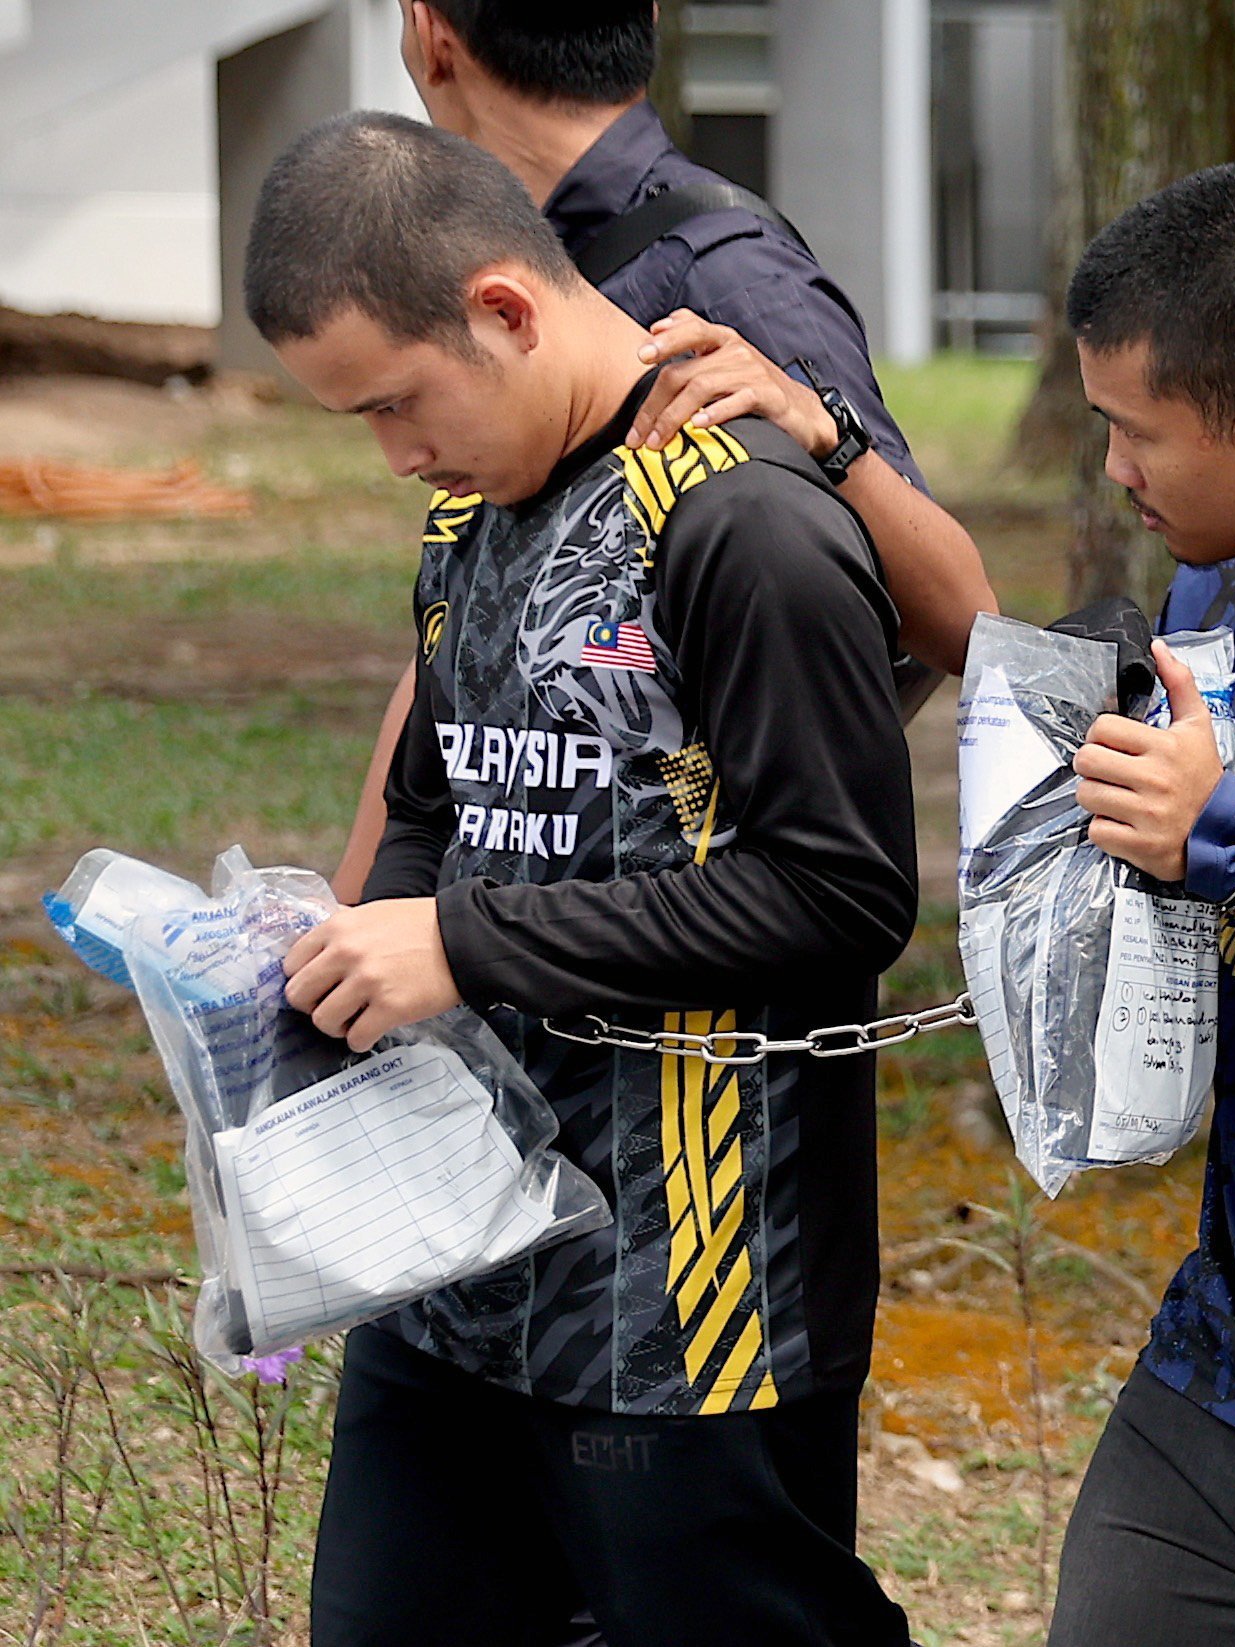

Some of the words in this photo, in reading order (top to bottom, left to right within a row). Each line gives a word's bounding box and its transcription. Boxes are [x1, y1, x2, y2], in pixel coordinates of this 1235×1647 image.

[435, 722, 612, 798] ALAYSIA
[454, 803, 578, 860] ARAKU
[255, 1110, 296, 1136] RANGKAIAN
[297, 1086, 340, 1115] KAWALAN
[340, 1066, 381, 1093] BARANG
[382, 1057, 404, 1074] OKT
